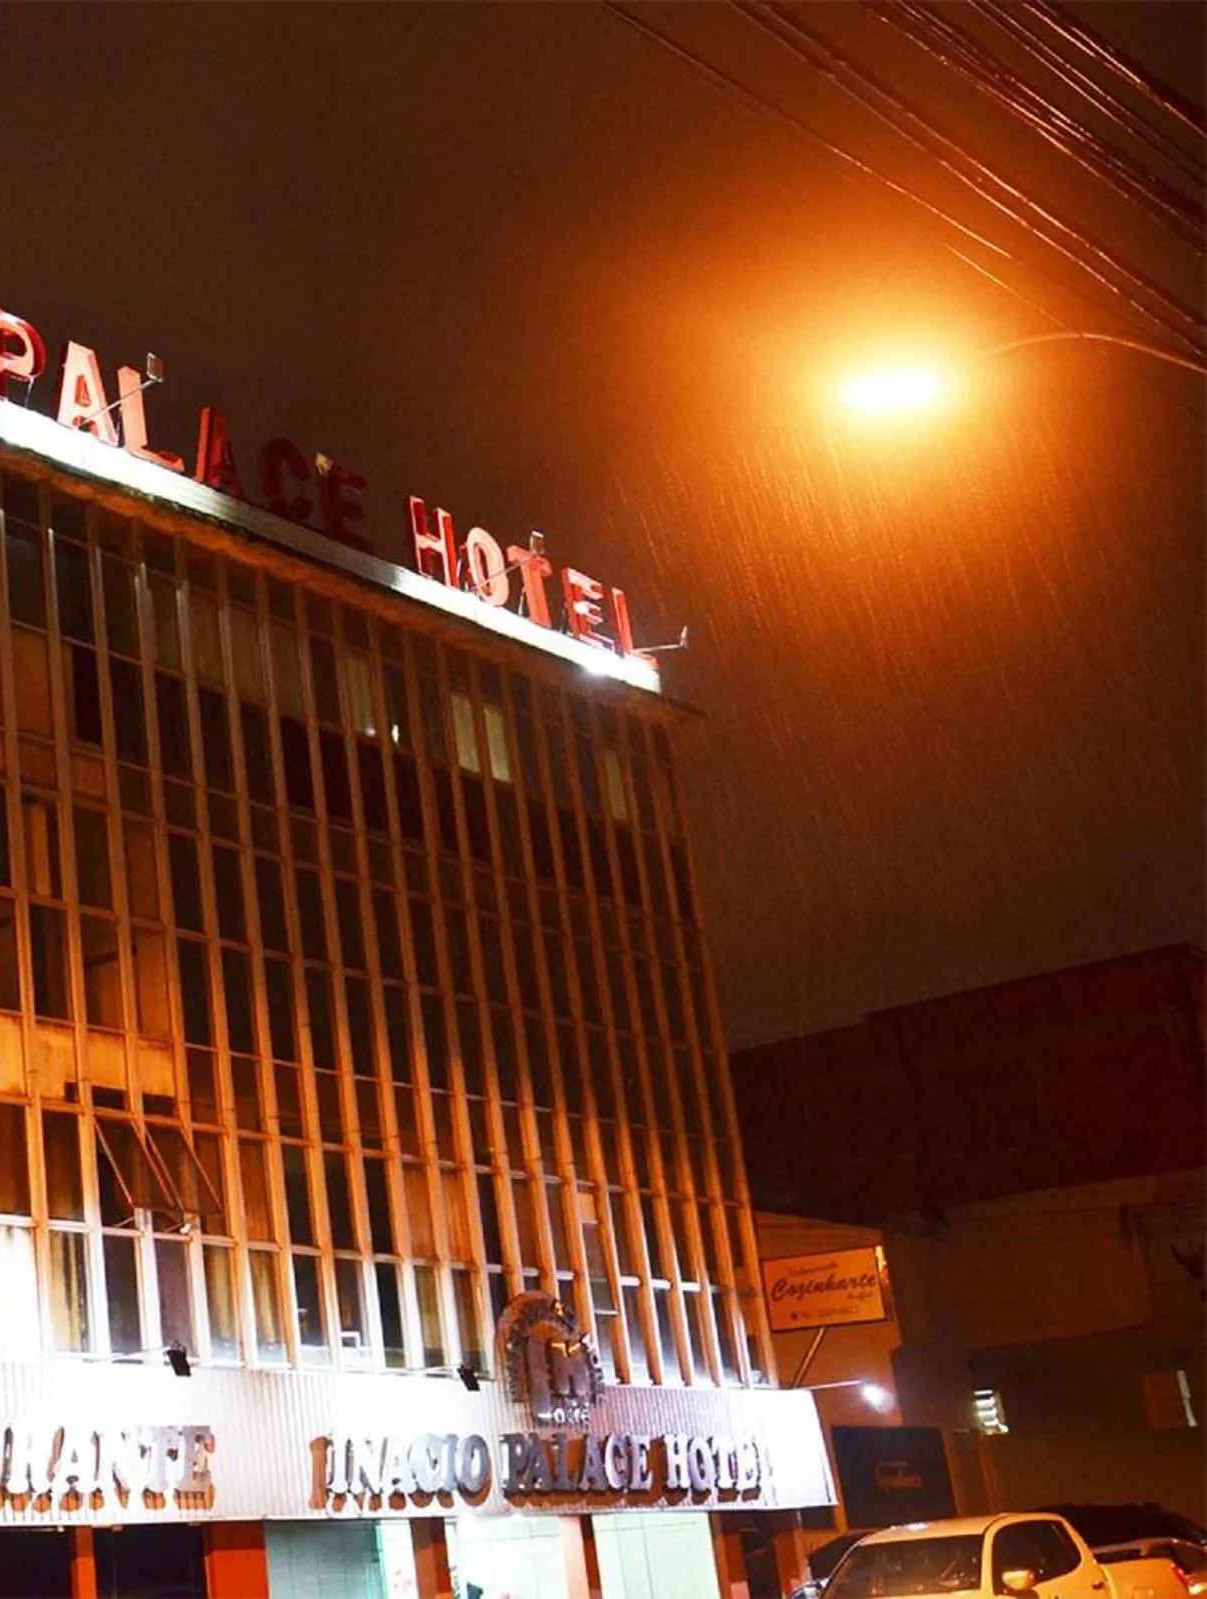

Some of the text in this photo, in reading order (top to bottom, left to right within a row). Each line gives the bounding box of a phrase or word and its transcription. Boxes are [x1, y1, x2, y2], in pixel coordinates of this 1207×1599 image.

[409, 495, 660, 669] HOTEL
[326, 1430, 492, 1494] INACIO
[500, 1430, 652, 1494] PALACE
